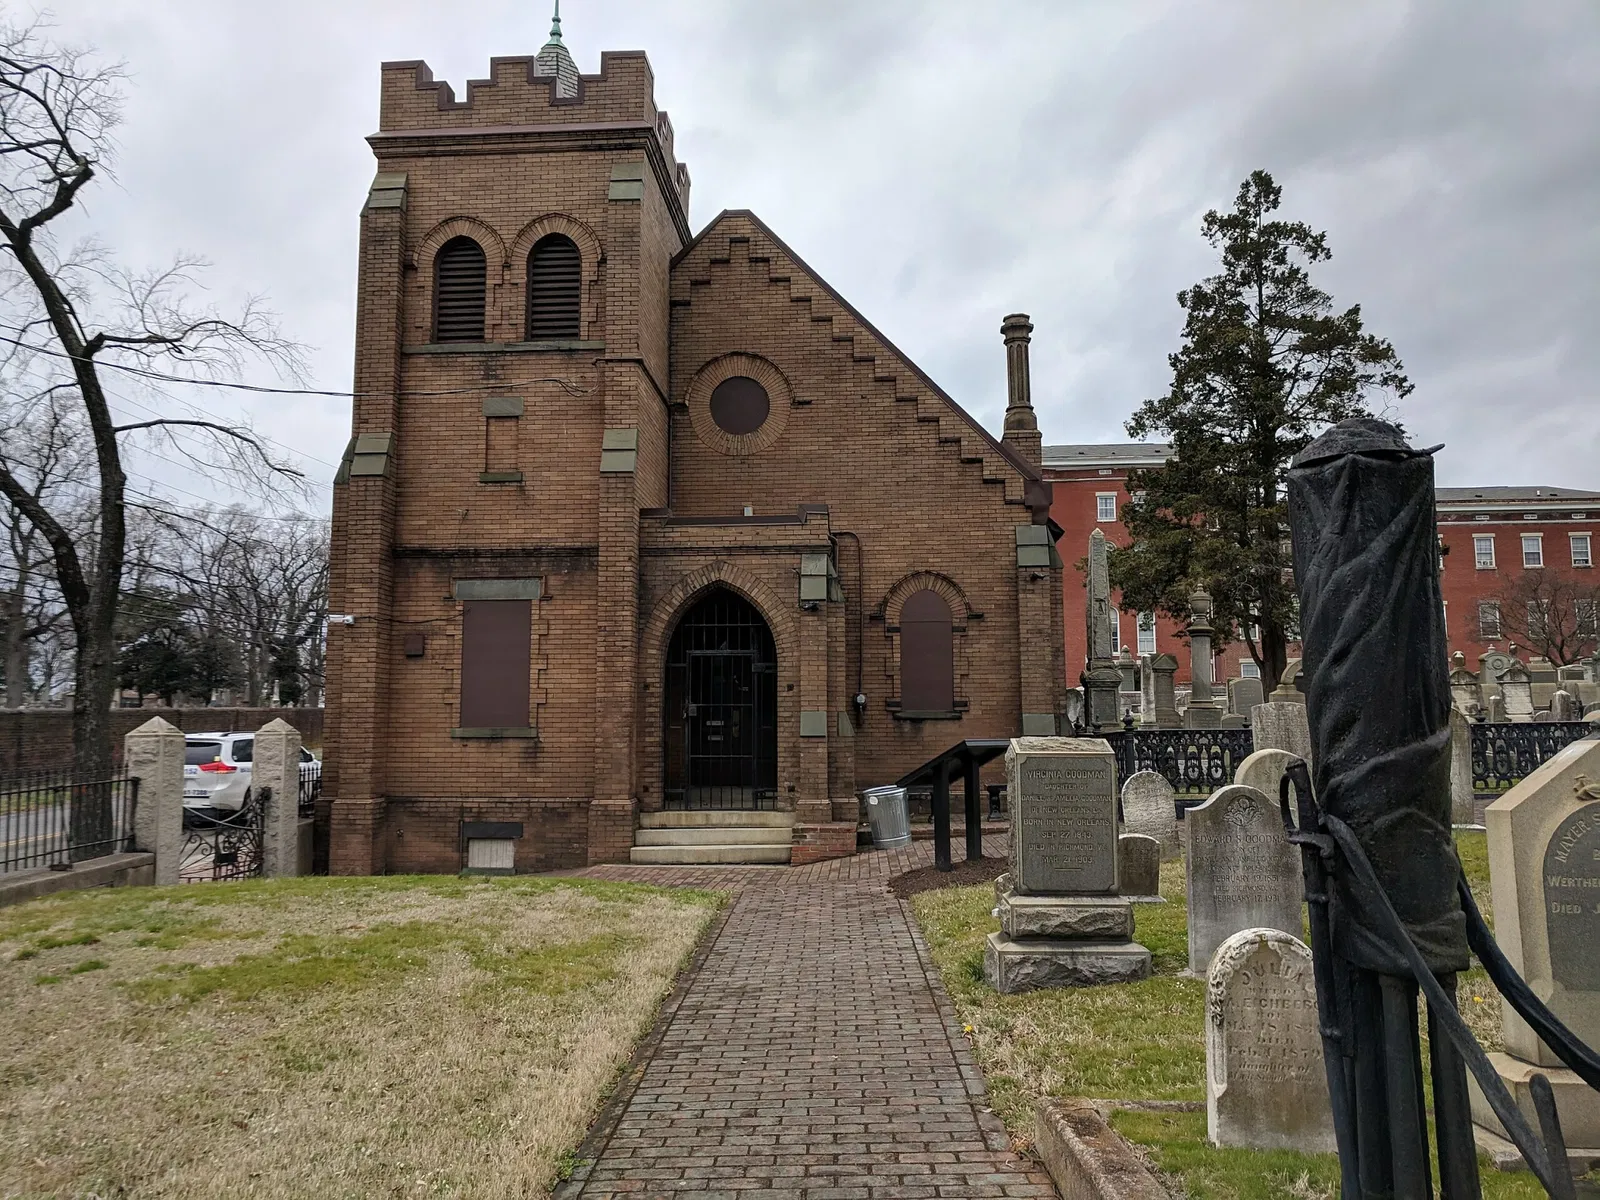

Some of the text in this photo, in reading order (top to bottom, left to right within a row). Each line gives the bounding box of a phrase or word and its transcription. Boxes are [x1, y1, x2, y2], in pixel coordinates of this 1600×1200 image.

[1026, 769, 1062, 779] VIRGINIA
[1044, 782, 1077, 790] DAUGHTER
[1023, 817, 1043, 826] BORN
[1046, 817, 1054, 826] IN
[1056, 817, 1074, 826] NEW
[1195, 834, 1232, 844] EDWARD
[1245, 834, 1286, 844] GOODMA
[1554, 820, 1592, 863] MAYER
[1028, 842, 1045, 851] DIED
[1213, 875, 1250, 883] FEBRUARY
[1213, 894, 1251, 903] FEBRUARY
[1551, 901, 1582, 914] DIED
[1242, 960, 1303, 986] JULIA
